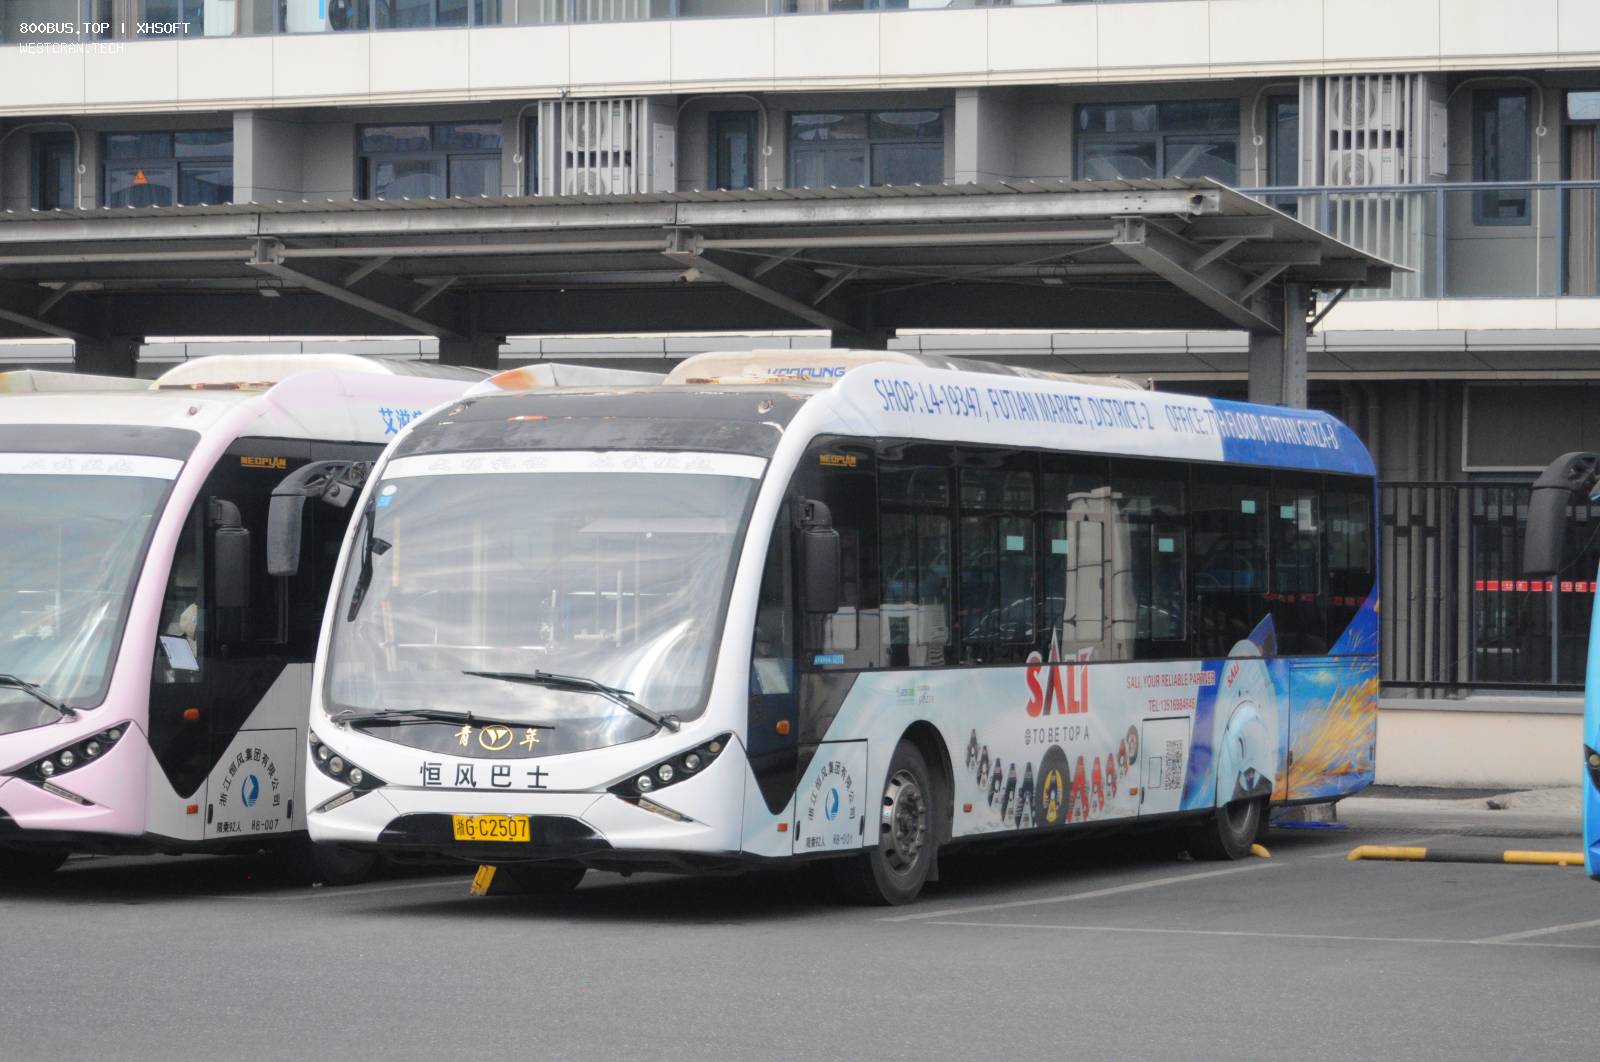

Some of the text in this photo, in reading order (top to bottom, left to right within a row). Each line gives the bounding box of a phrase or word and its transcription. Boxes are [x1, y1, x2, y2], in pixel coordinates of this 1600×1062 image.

[240, 456, 287, 467] NEOPLAN
[1033, 728, 1045, 744] TO
[1048, 727, 1060, 743] BE
[1063, 726, 1080, 742] TOP
[419, 761, 549, 789] 恒风巴士
